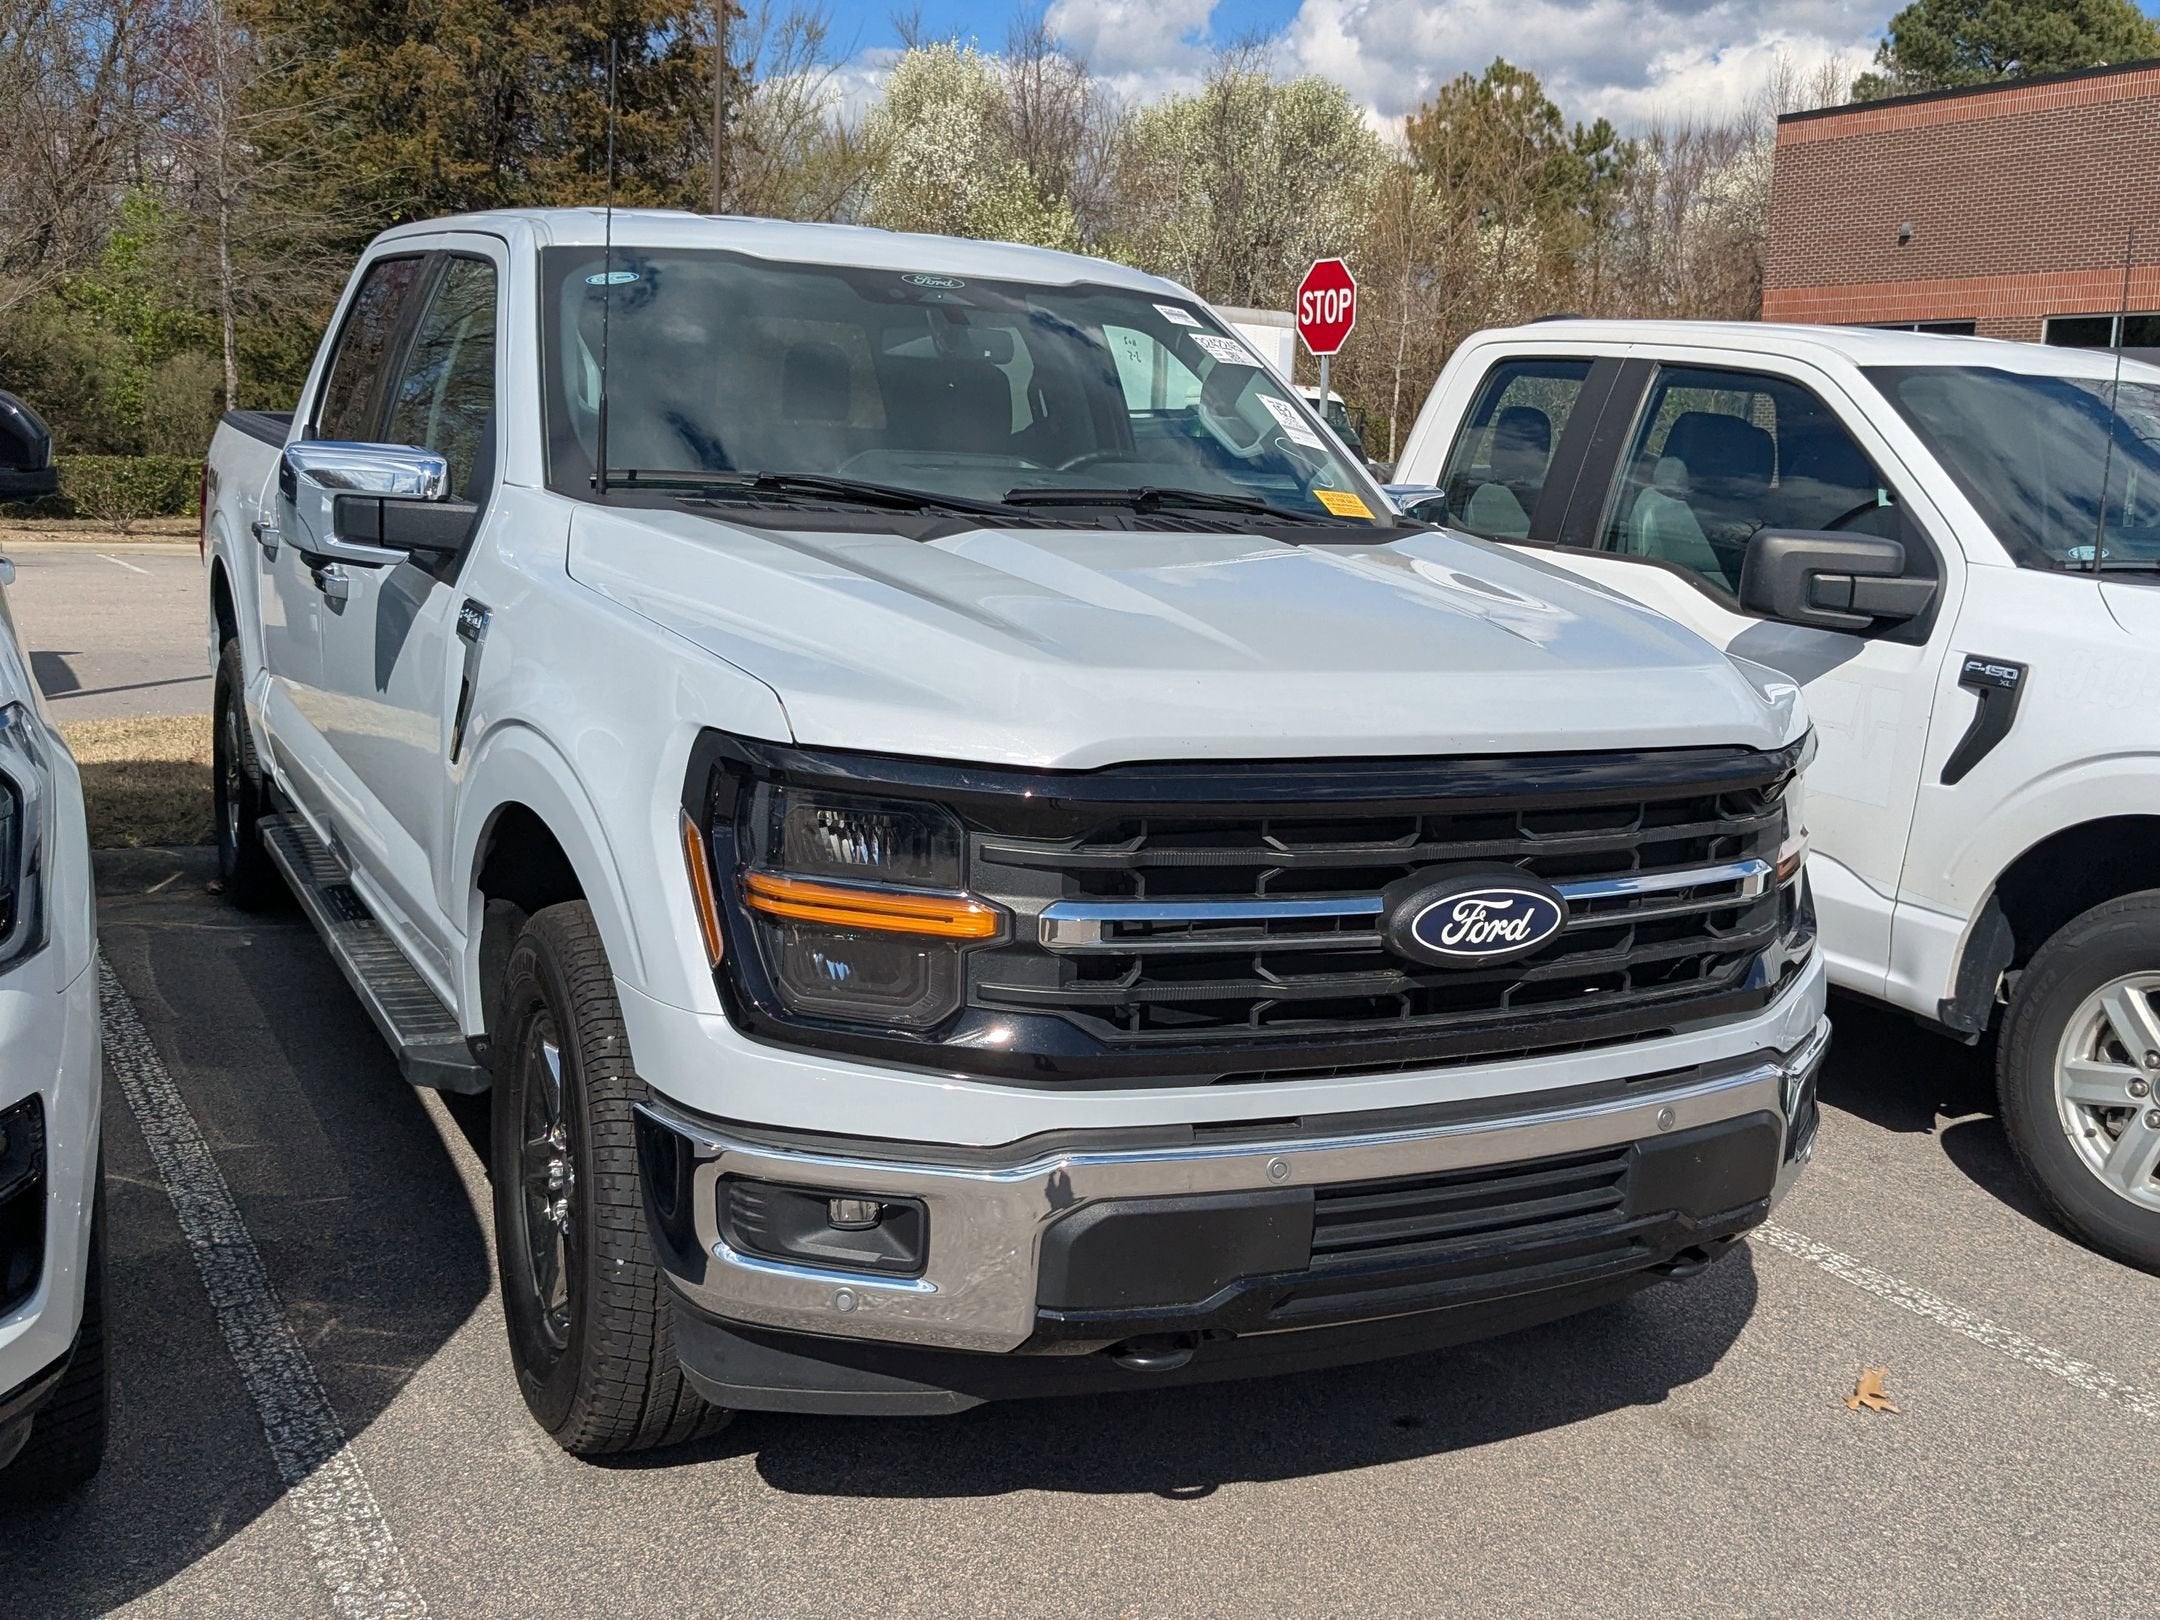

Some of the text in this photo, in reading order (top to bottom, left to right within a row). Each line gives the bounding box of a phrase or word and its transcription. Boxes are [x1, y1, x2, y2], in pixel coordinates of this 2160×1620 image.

[914, 275, 954, 287] Ford
[1301, 288, 1352, 325] STOP
[1965, 661, 2018, 680] F-150
[2000, 680, 2012, 688] XL
[1441, 899, 1535, 945] Ford
